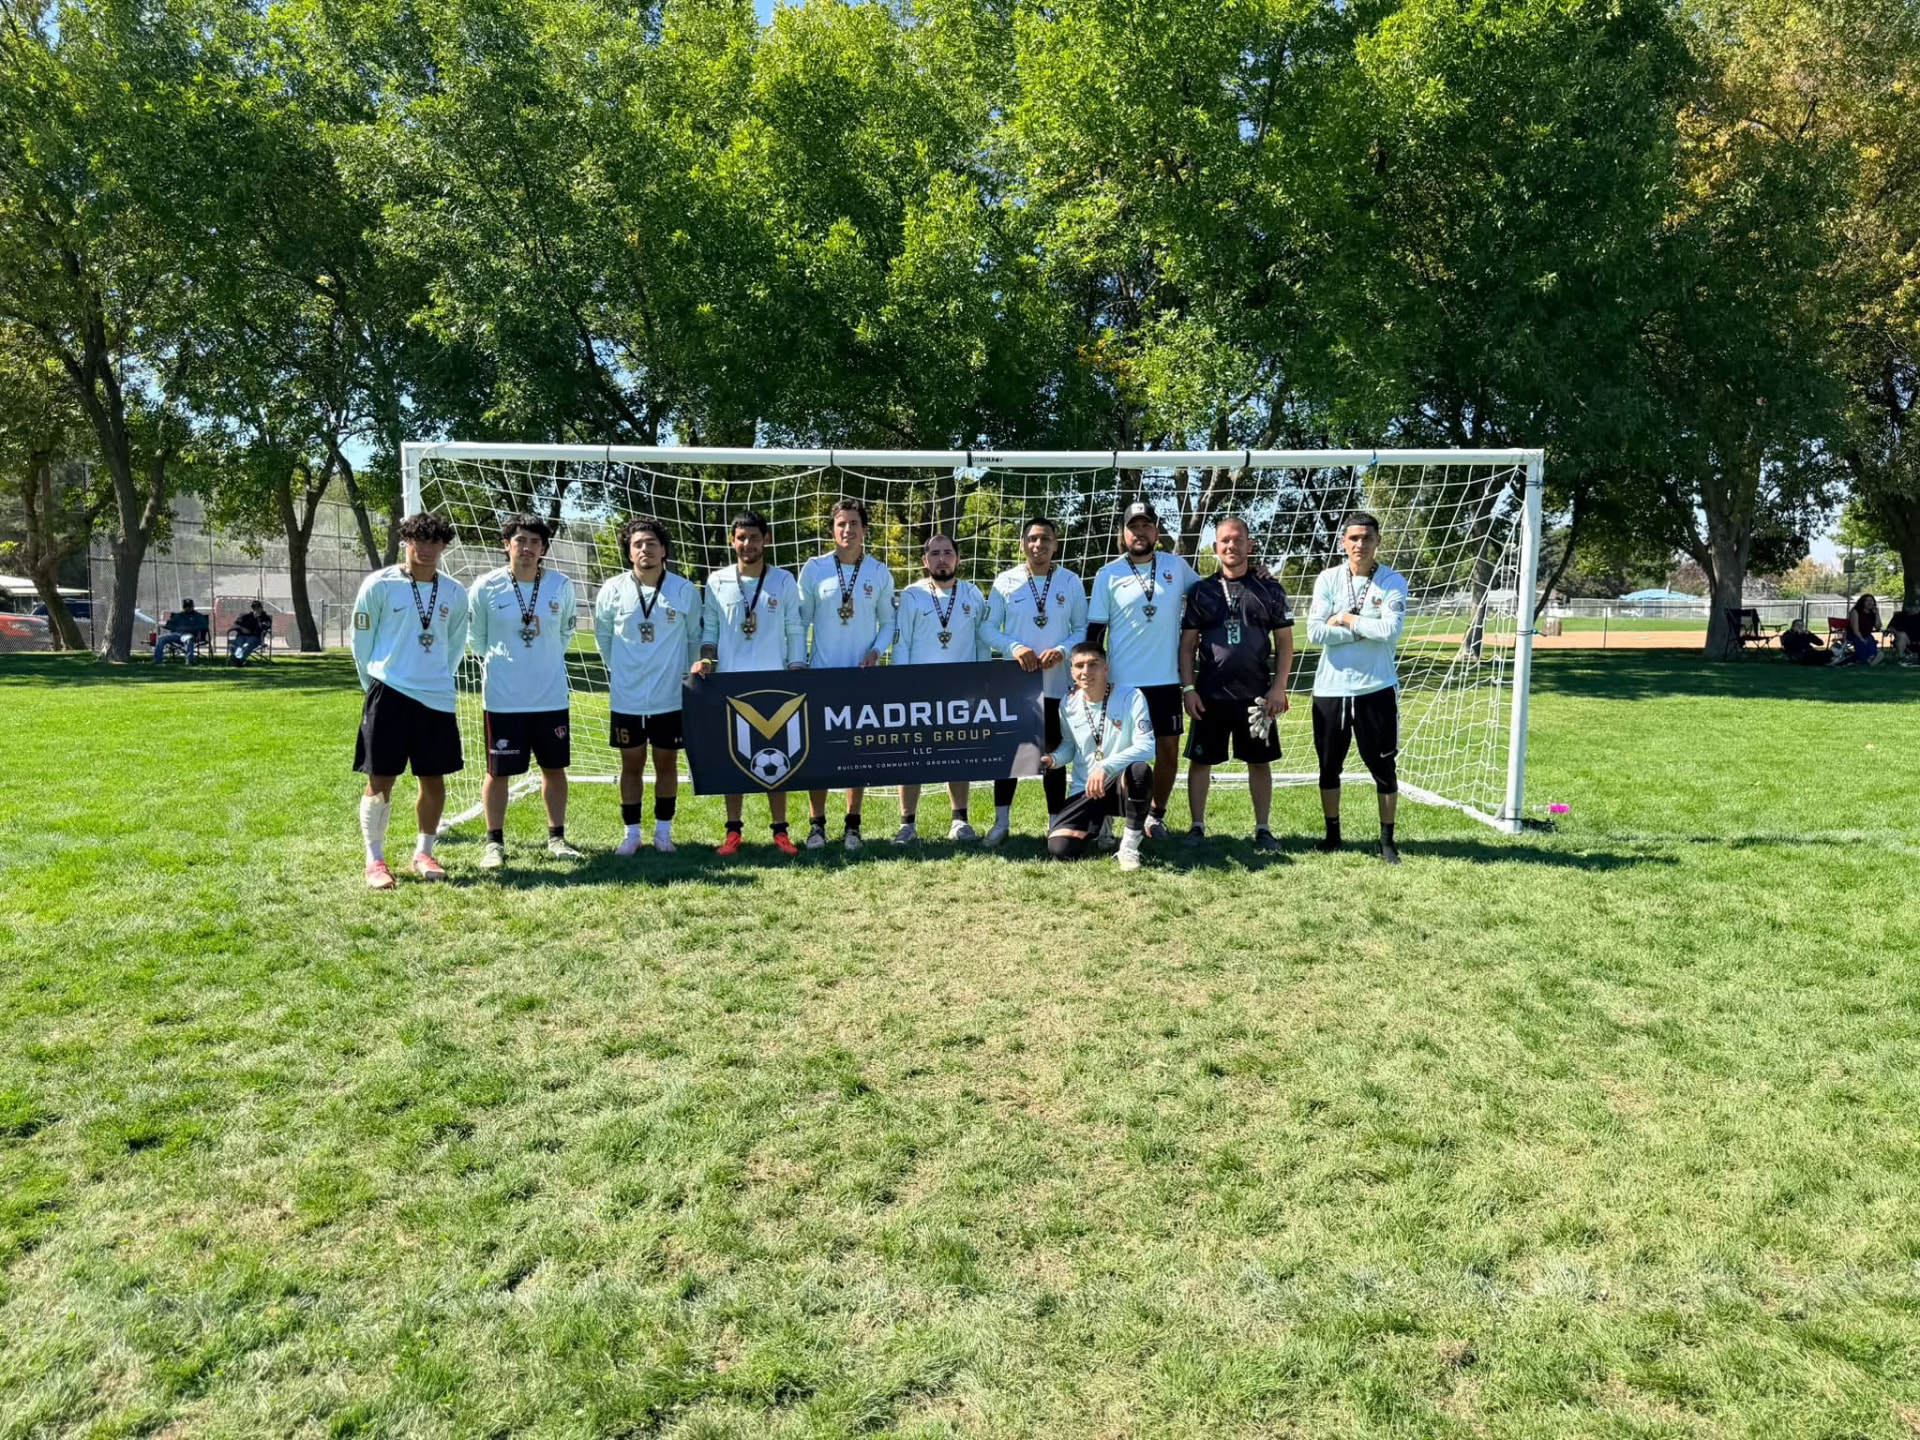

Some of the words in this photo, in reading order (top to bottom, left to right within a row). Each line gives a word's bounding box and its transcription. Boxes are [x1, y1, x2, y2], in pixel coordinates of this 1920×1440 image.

[824, 698, 1018, 731] MADRIGAL
[615, 727, 630, 745] 16
[853, 732, 923, 746] SPORTS
[933, 728, 992, 742] GROUP
[912, 746, 933, 755] LLC
